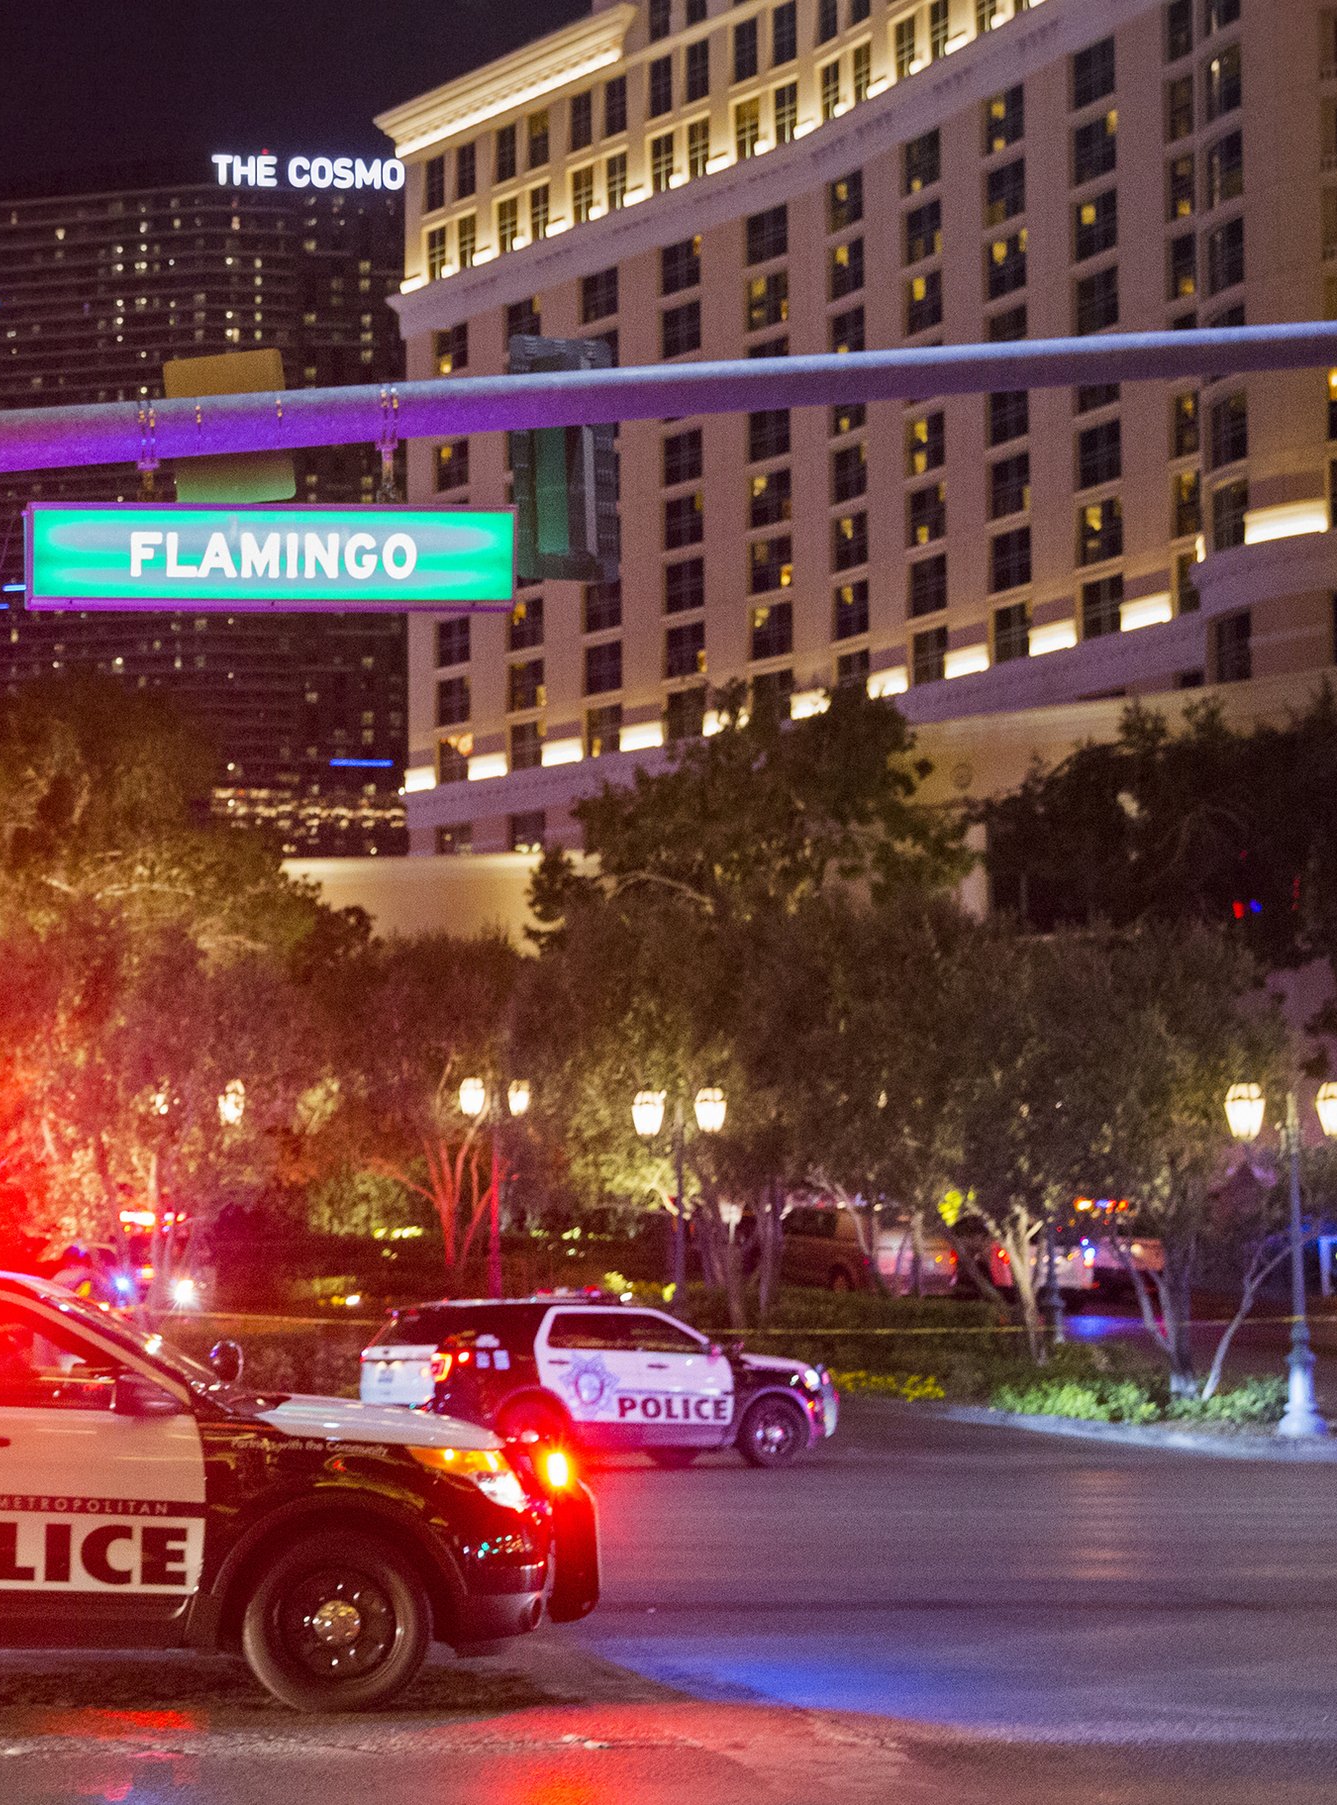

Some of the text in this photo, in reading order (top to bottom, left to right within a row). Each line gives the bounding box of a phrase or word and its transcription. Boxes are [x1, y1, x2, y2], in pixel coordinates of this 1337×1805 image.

[211, 154, 405, 190] THE COSMO
[130, 532, 417, 579] FLAMINGO
[619, 1397, 727, 1420] POLICE
